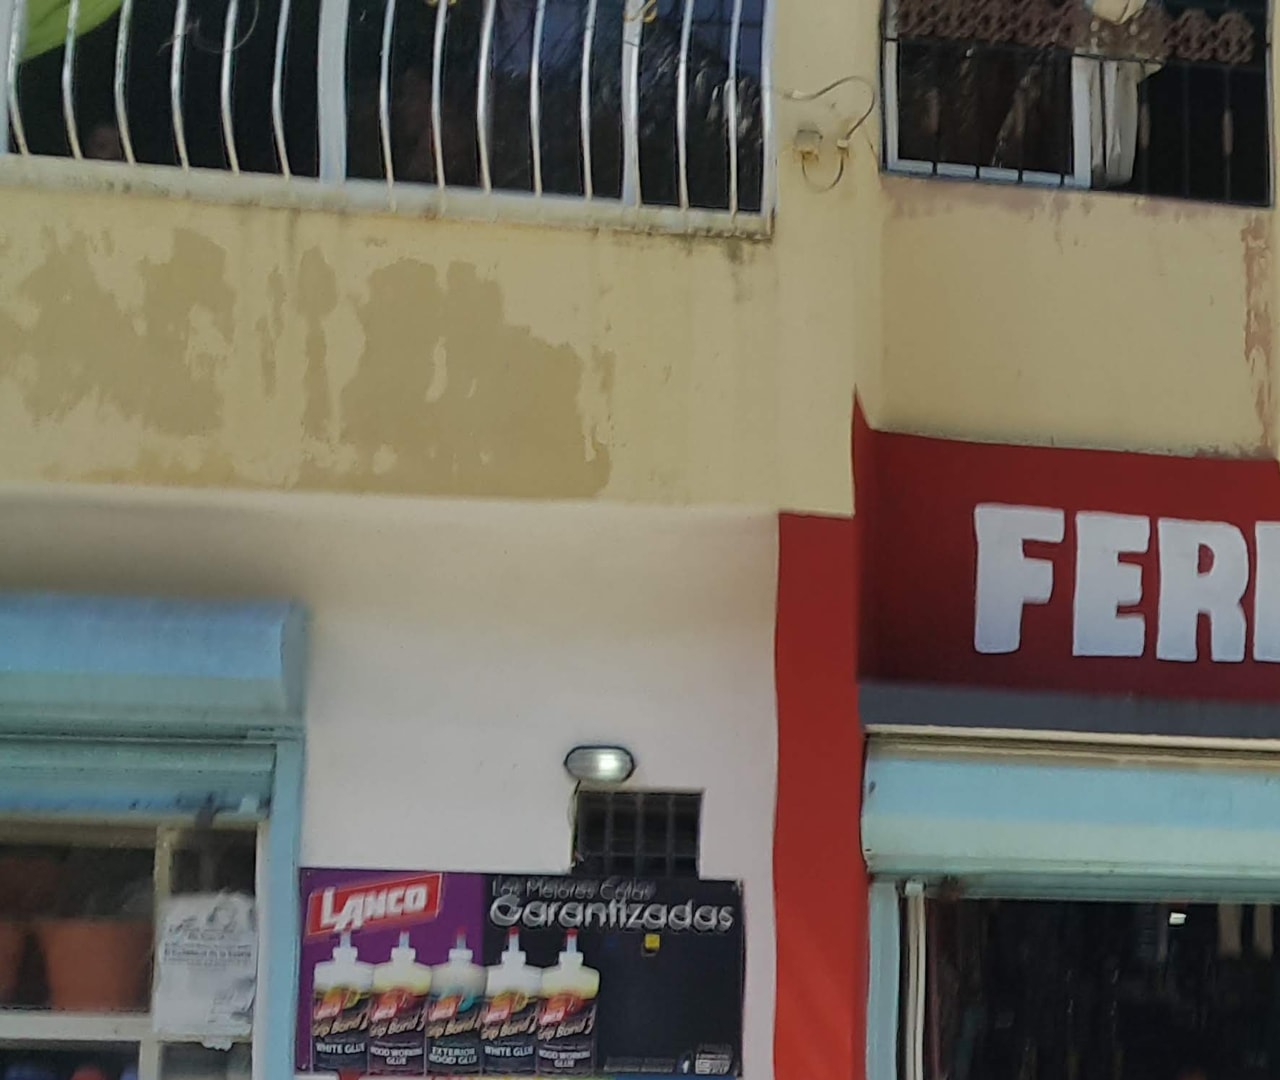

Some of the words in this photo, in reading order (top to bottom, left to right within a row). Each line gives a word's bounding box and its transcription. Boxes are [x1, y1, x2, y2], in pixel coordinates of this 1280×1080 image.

[320, 886, 428, 933] LANCO
[526, 880, 594, 900] Mejores
[489, 894, 735, 934] Garantizadas
